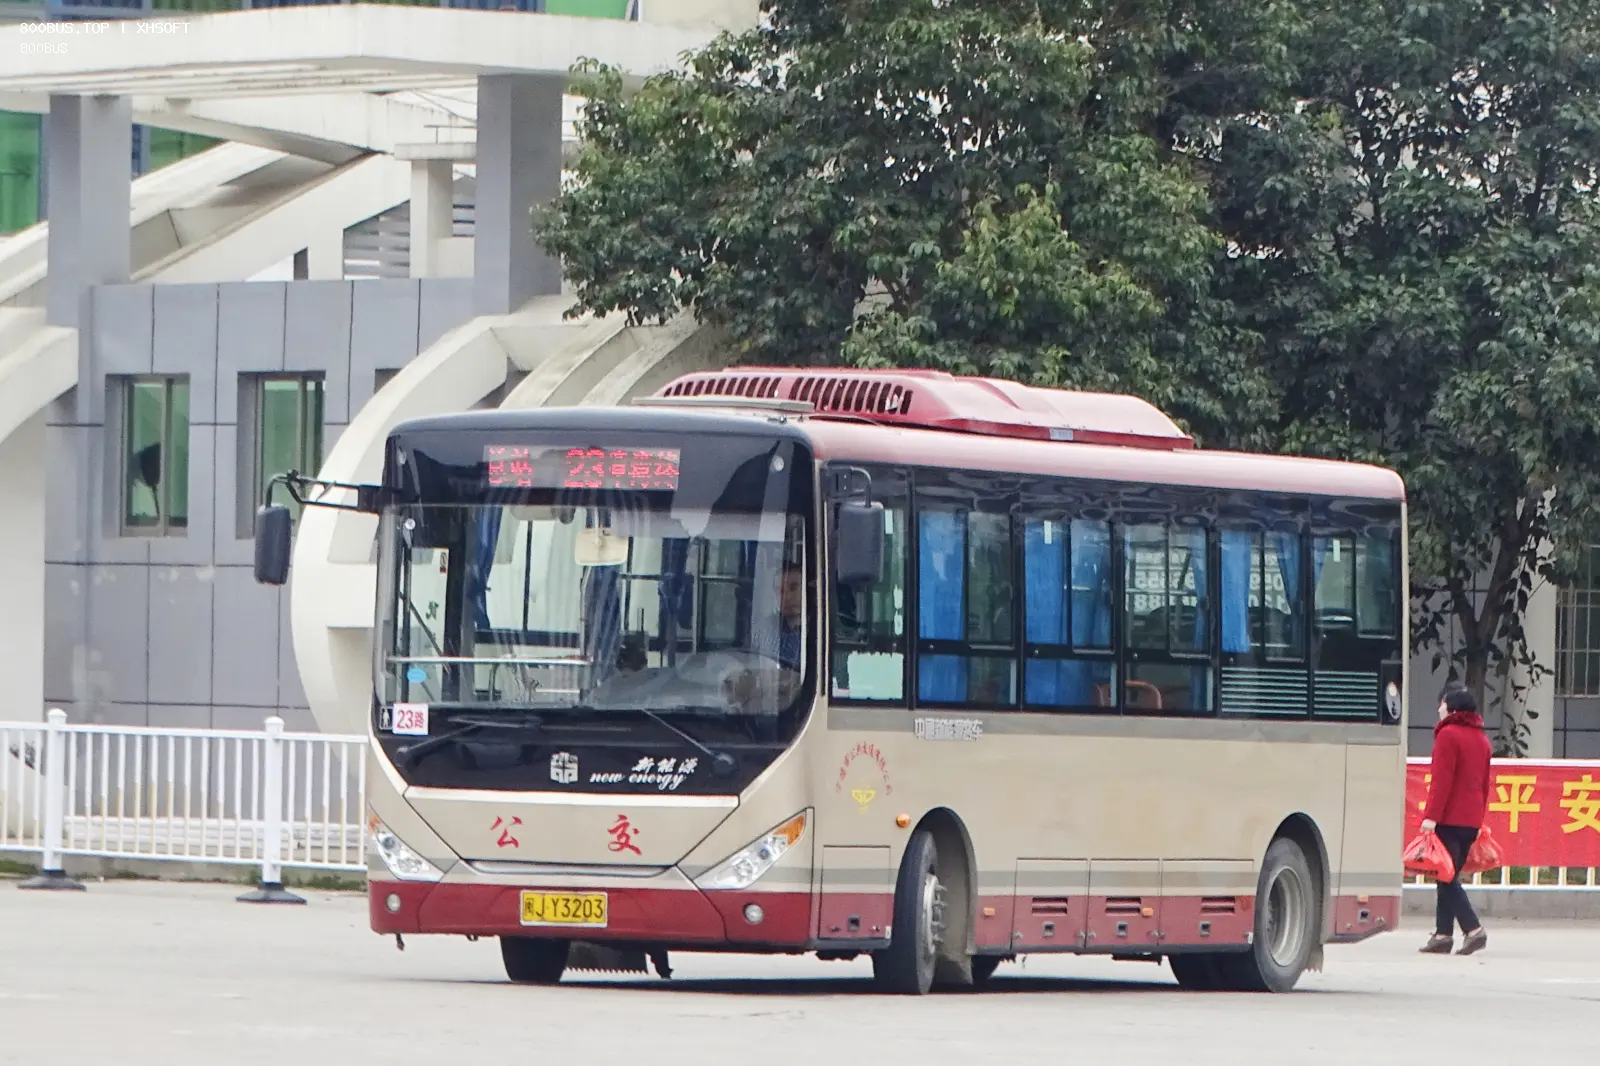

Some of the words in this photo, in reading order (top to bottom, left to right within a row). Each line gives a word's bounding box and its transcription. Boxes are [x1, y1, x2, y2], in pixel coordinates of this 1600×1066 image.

[589, 771, 626, 783] new
[628, 771, 688, 790] energy
[1417, 774, 1600, 834] 平安
[490, 814, 642, 856] 公交
